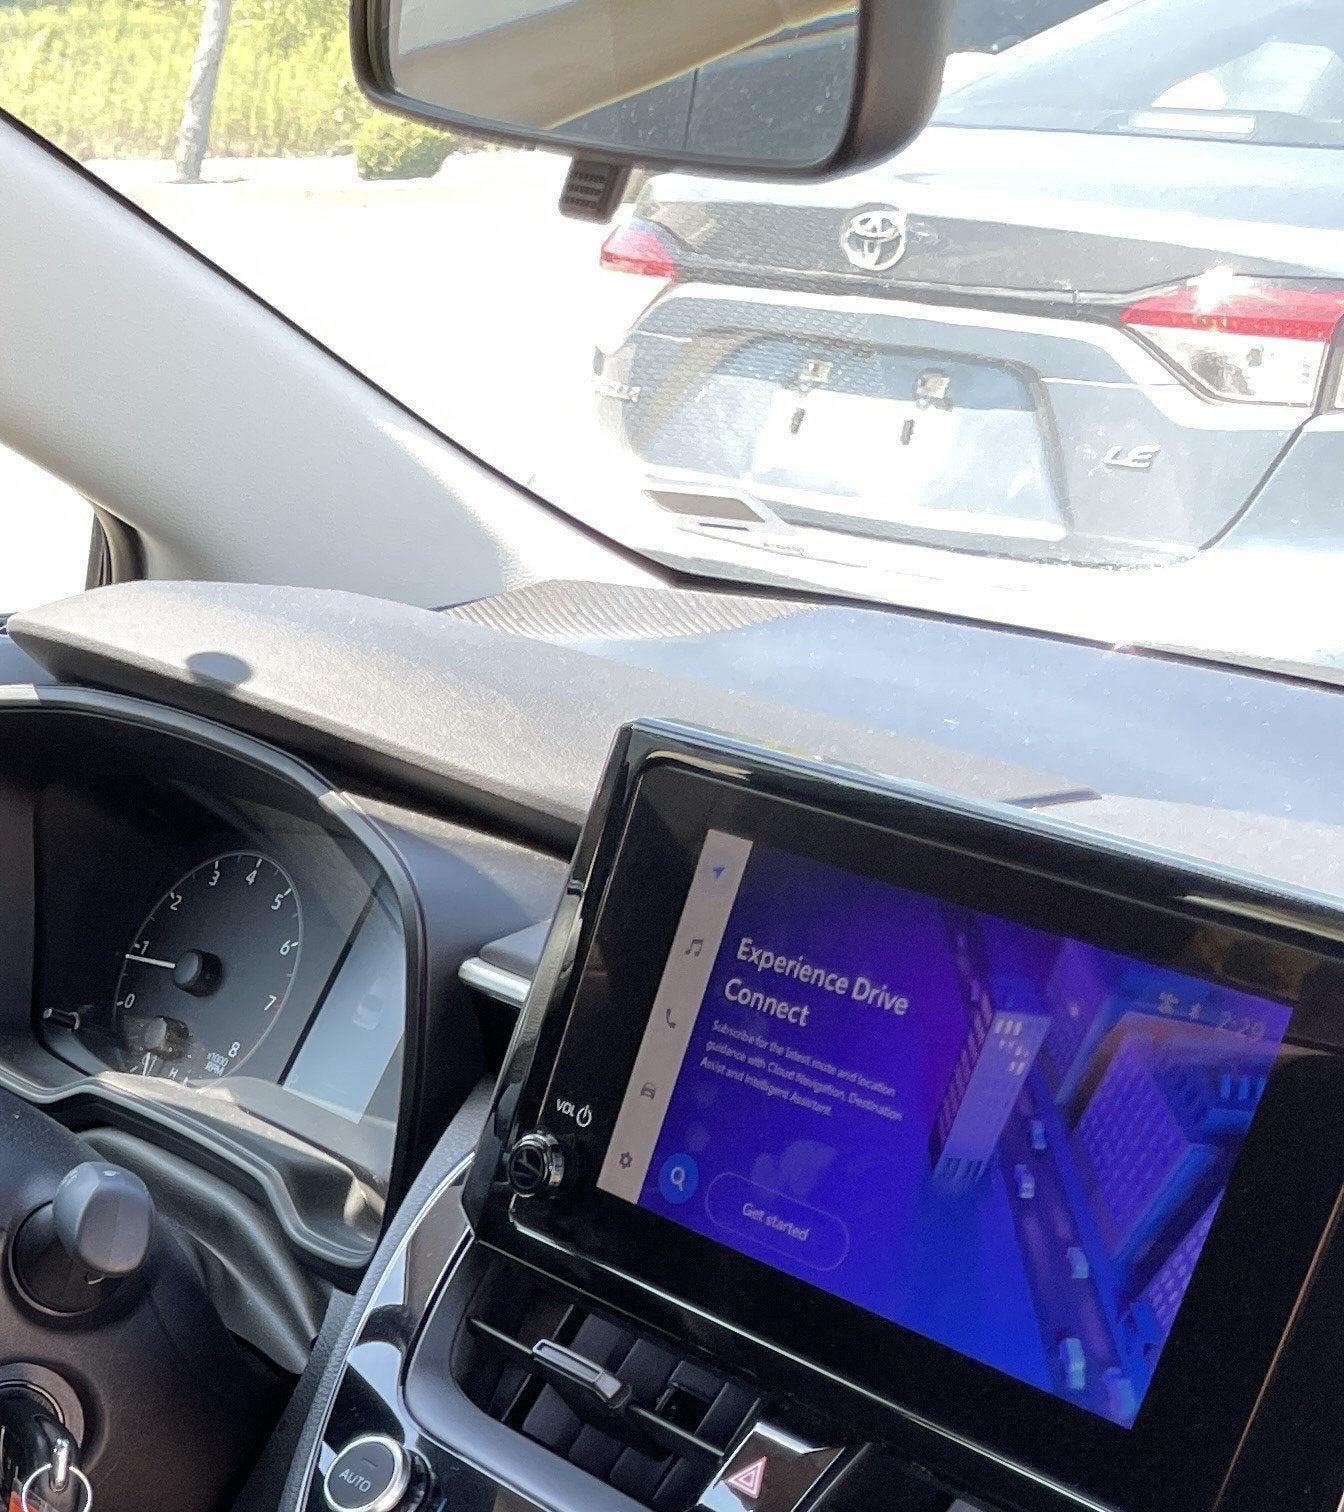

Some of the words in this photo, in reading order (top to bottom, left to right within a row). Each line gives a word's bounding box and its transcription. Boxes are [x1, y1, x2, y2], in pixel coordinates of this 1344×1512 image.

[1101, 444, 1162, 471] LE
[209, 870, 221, 886] 3
[245, 870, 257, 886] 4
[169, 894, 183, 911] 2
[271, 893, 285, 910] 5
[279, 939, 291, 956] 6
[736, 937, 849, 995] Experience
[850, 976, 910, 1016] Drive
[124, 993, 136, 1009] 0
[264, 994, 277, 1011] 7
[724, 977, 811, 1027] Connect
[228, 1041, 241, 1058] 8
[711, 1019, 755, 1046] Subscribe
[769, 1041, 786, 1056] the
[837, 1066, 859, 1083] and
[857, 1074, 897, 1098] location
[705, 1040, 747, 1062] guidance
[767, 1061, 797, 1081] Cloud
[556, 1098, 576, 1118] VOL
[742, 1203, 765, 1223] Get
[766, 1214, 811, 1242] started
[339, 1468, 372, 1493] AUTO
